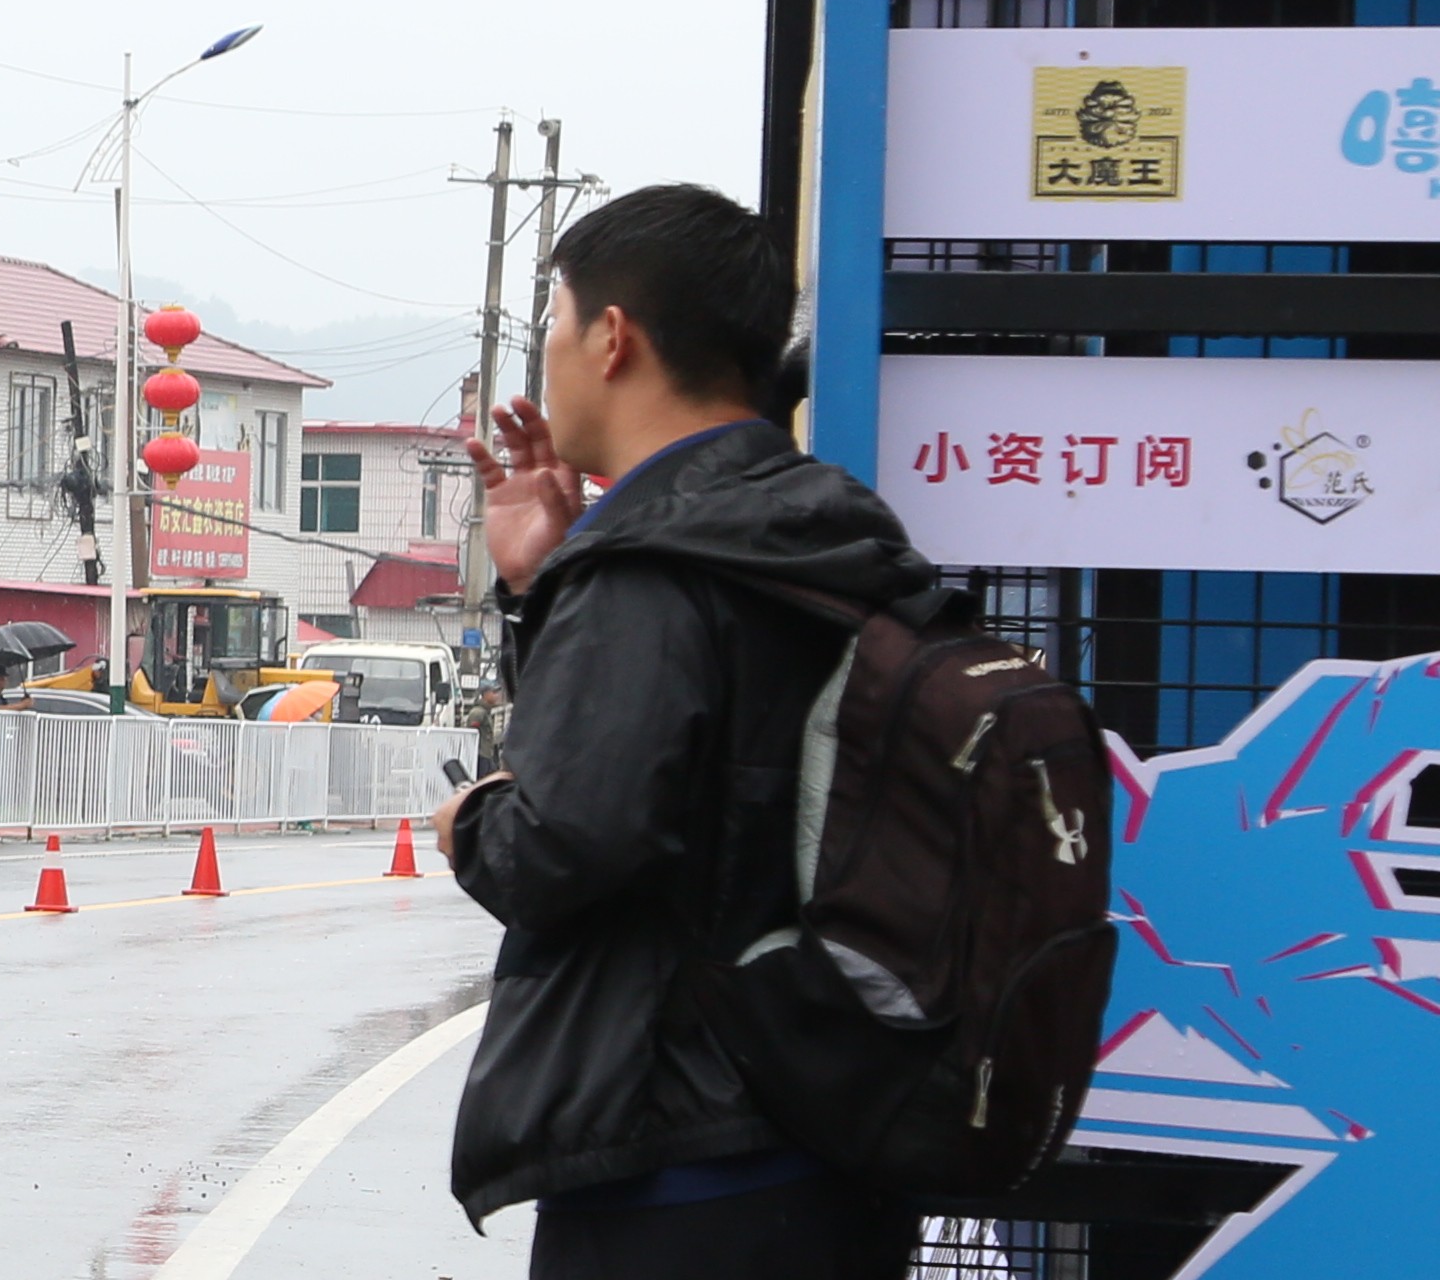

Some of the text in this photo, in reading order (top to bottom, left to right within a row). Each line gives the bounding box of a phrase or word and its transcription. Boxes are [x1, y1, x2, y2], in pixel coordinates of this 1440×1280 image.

[1048, 157, 1164, 186] 大魔王
[912, 430, 1193, 489] 小资订阅
[1324, 470, 1375, 494] 范氏
